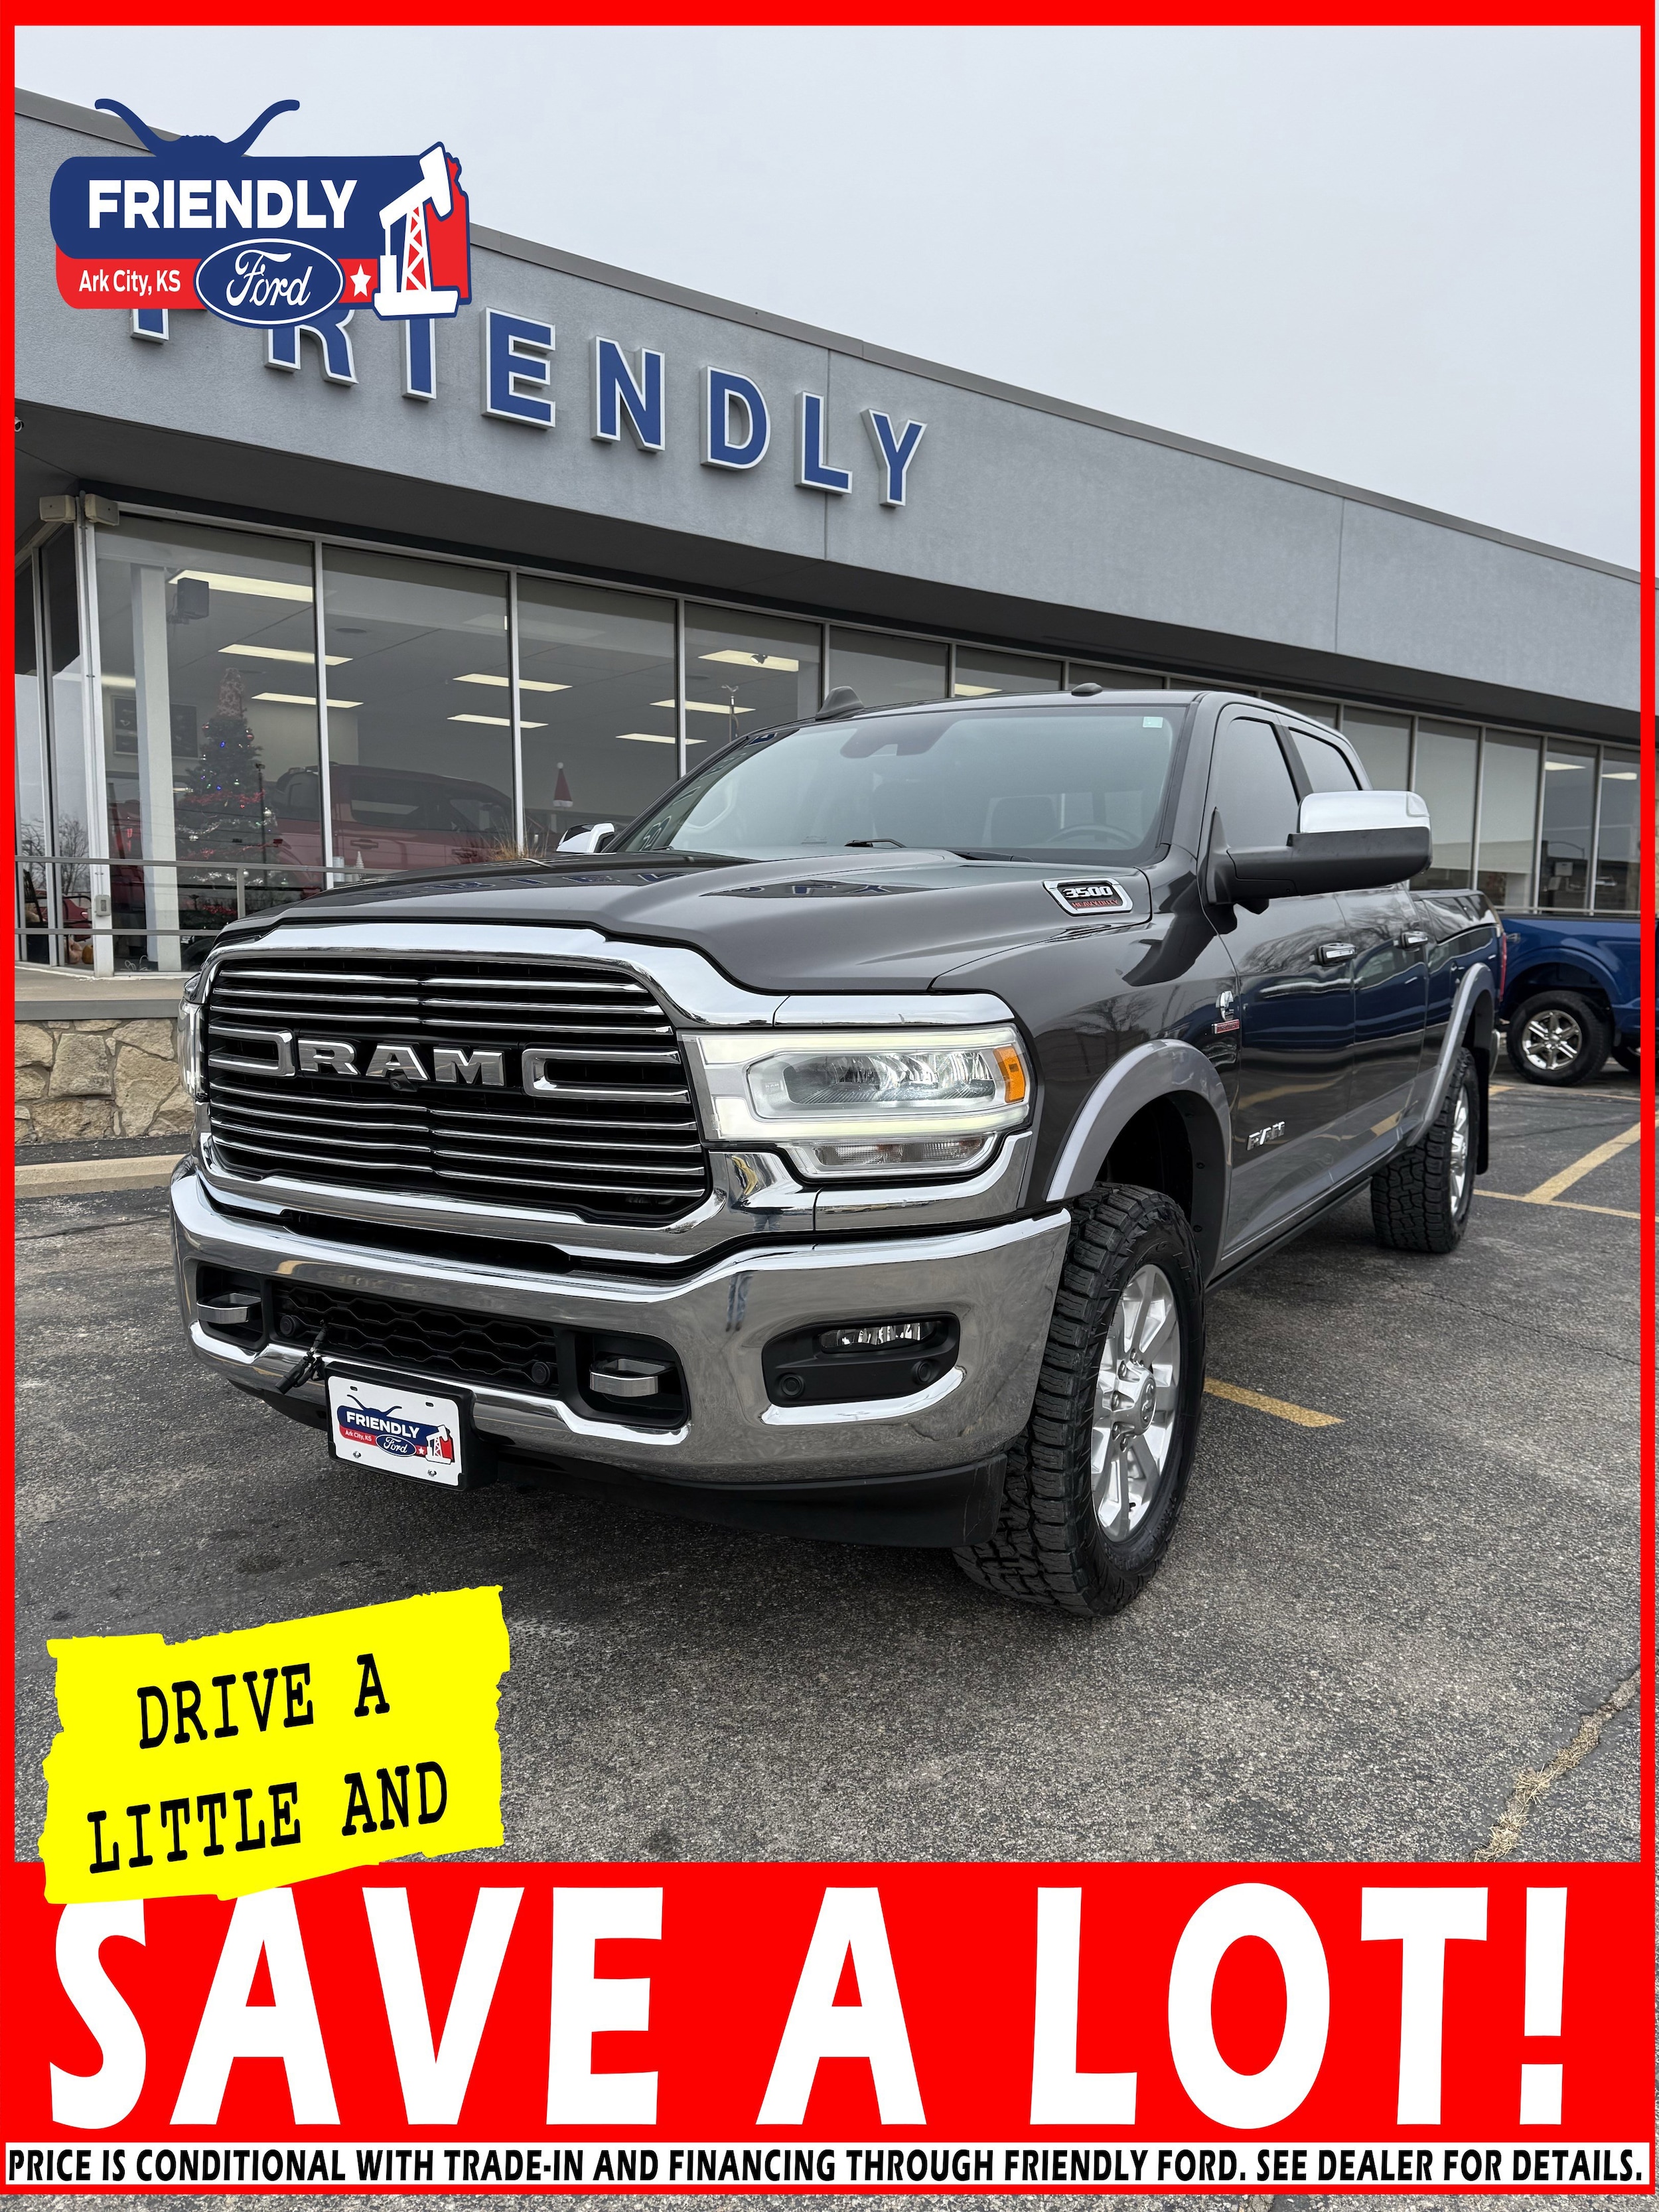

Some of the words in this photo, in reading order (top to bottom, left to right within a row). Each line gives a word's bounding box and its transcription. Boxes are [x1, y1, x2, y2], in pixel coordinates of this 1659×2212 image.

[131, 306, 927, 508] RIENDLY
[1062, 886, 1114, 899] 3500
[297, 1038, 505, 1086] RAM
[346, 1411, 420, 1439] FRIENDLY
[354, 1432, 364, 1440] City,
[383, 1436, 408, 1453] Ford
